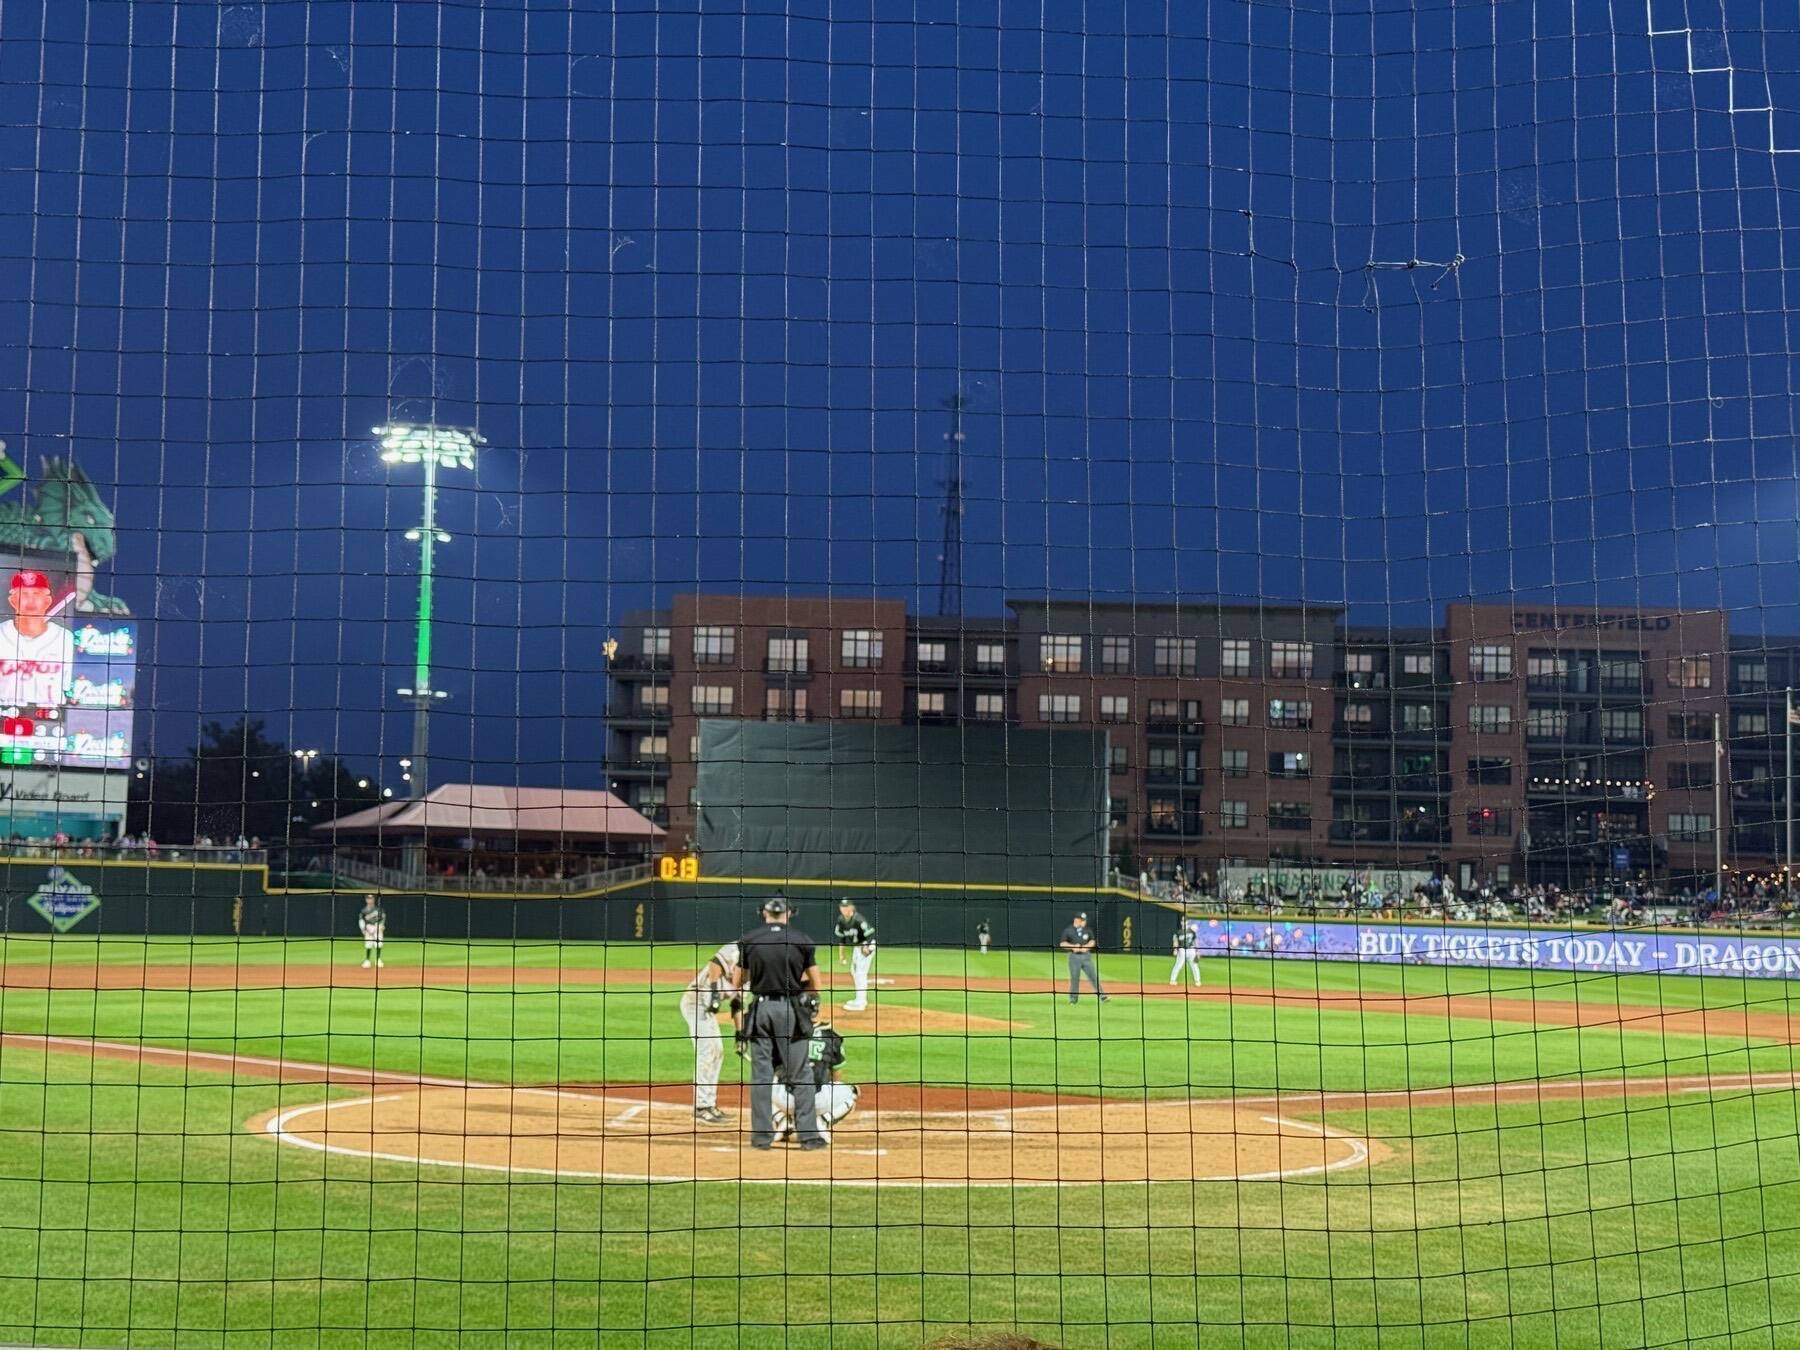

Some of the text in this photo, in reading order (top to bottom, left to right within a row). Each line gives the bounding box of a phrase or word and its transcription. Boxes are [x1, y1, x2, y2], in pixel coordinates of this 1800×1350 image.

[1512, 612, 1671, 631] CENTERFIELD
[635, 903, 644, 937] 402
[1122, 916, 1132, 951] 402
[1359, 932, 1417, 957] BUY
[1422, 934, 1540, 962] TICKETS
[1546, 938, 1647, 967] TODAY
